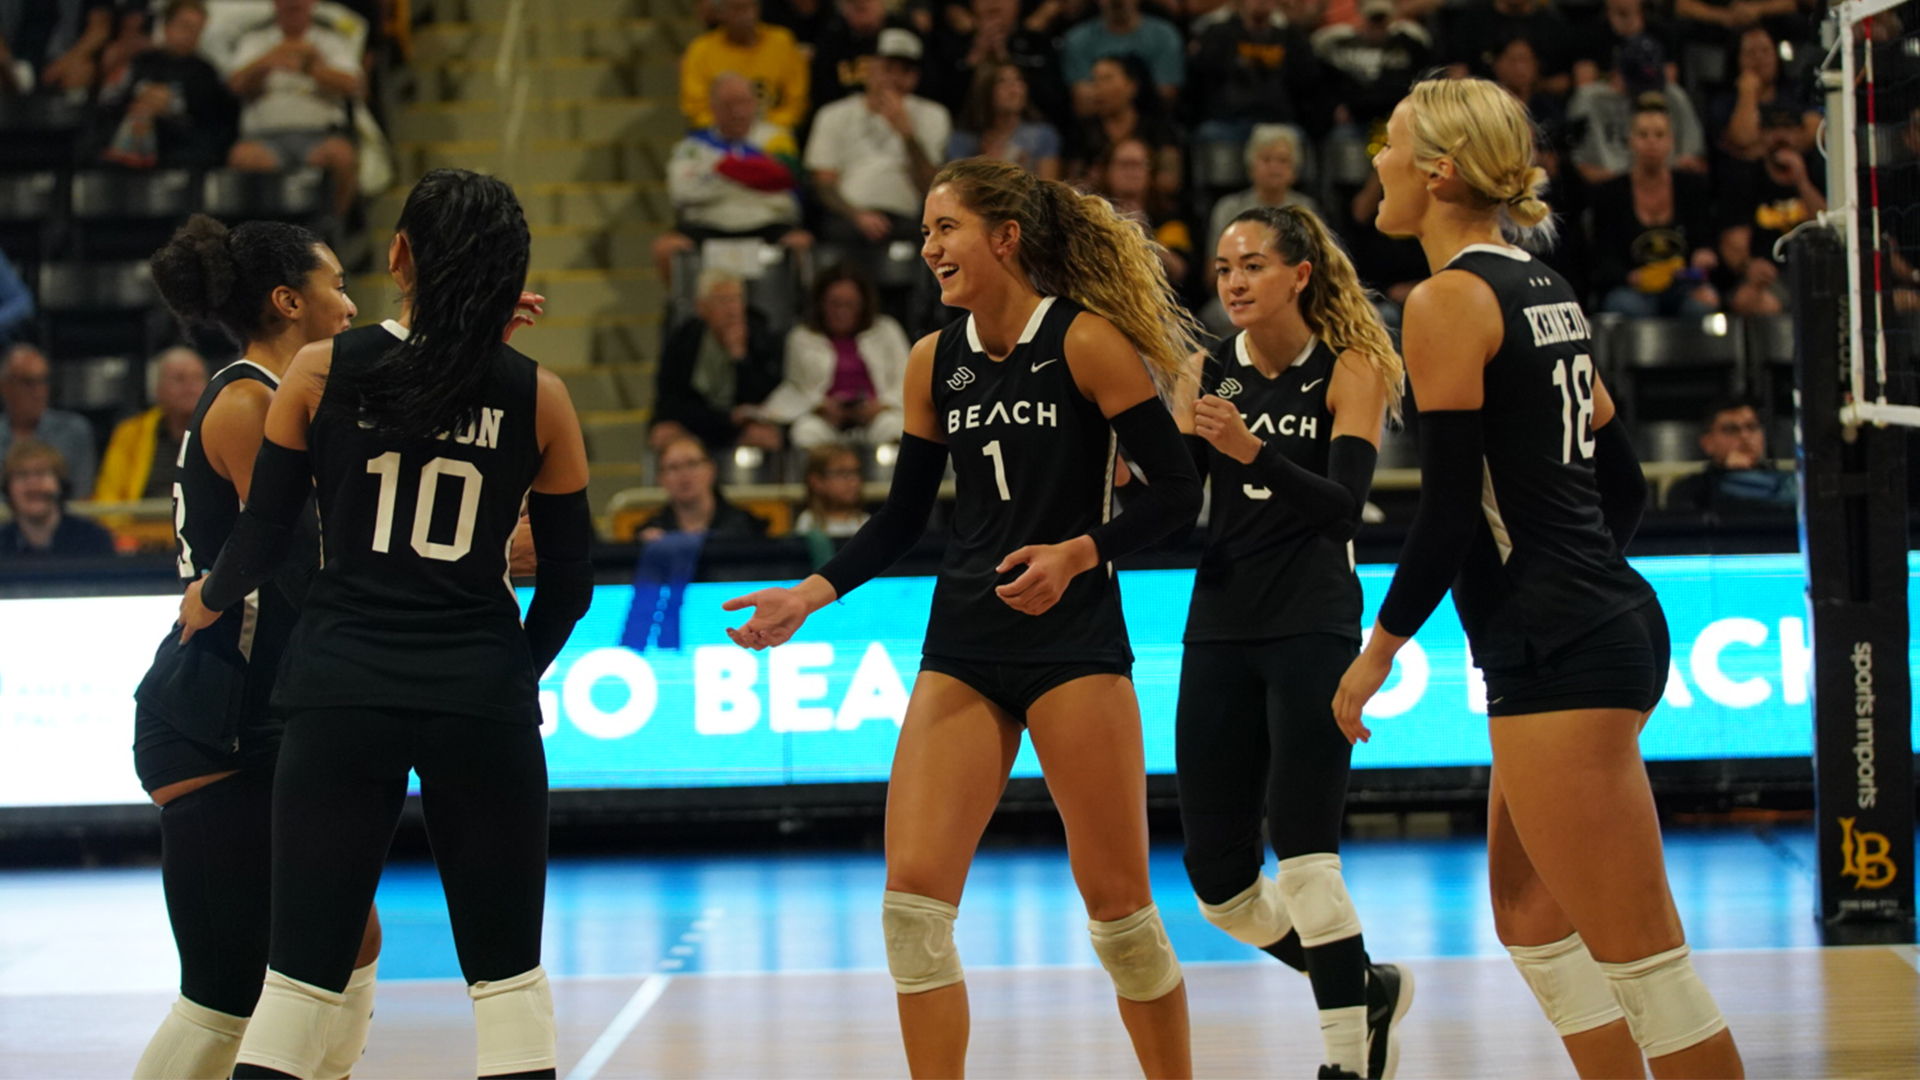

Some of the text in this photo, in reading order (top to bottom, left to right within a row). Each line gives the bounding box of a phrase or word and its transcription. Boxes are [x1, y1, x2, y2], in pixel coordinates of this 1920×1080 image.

[948, 401, 1057, 434] BEACH
[1240, 413, 1317, 439] ACH
[1552, 354, 1595, 465] 18
[366, 451, 483, 562] 10
[982, 440, 1011, 500] 1
[540, 641, 911, 739] O BEA
[1850, 642, 1878, 809] sports imports
